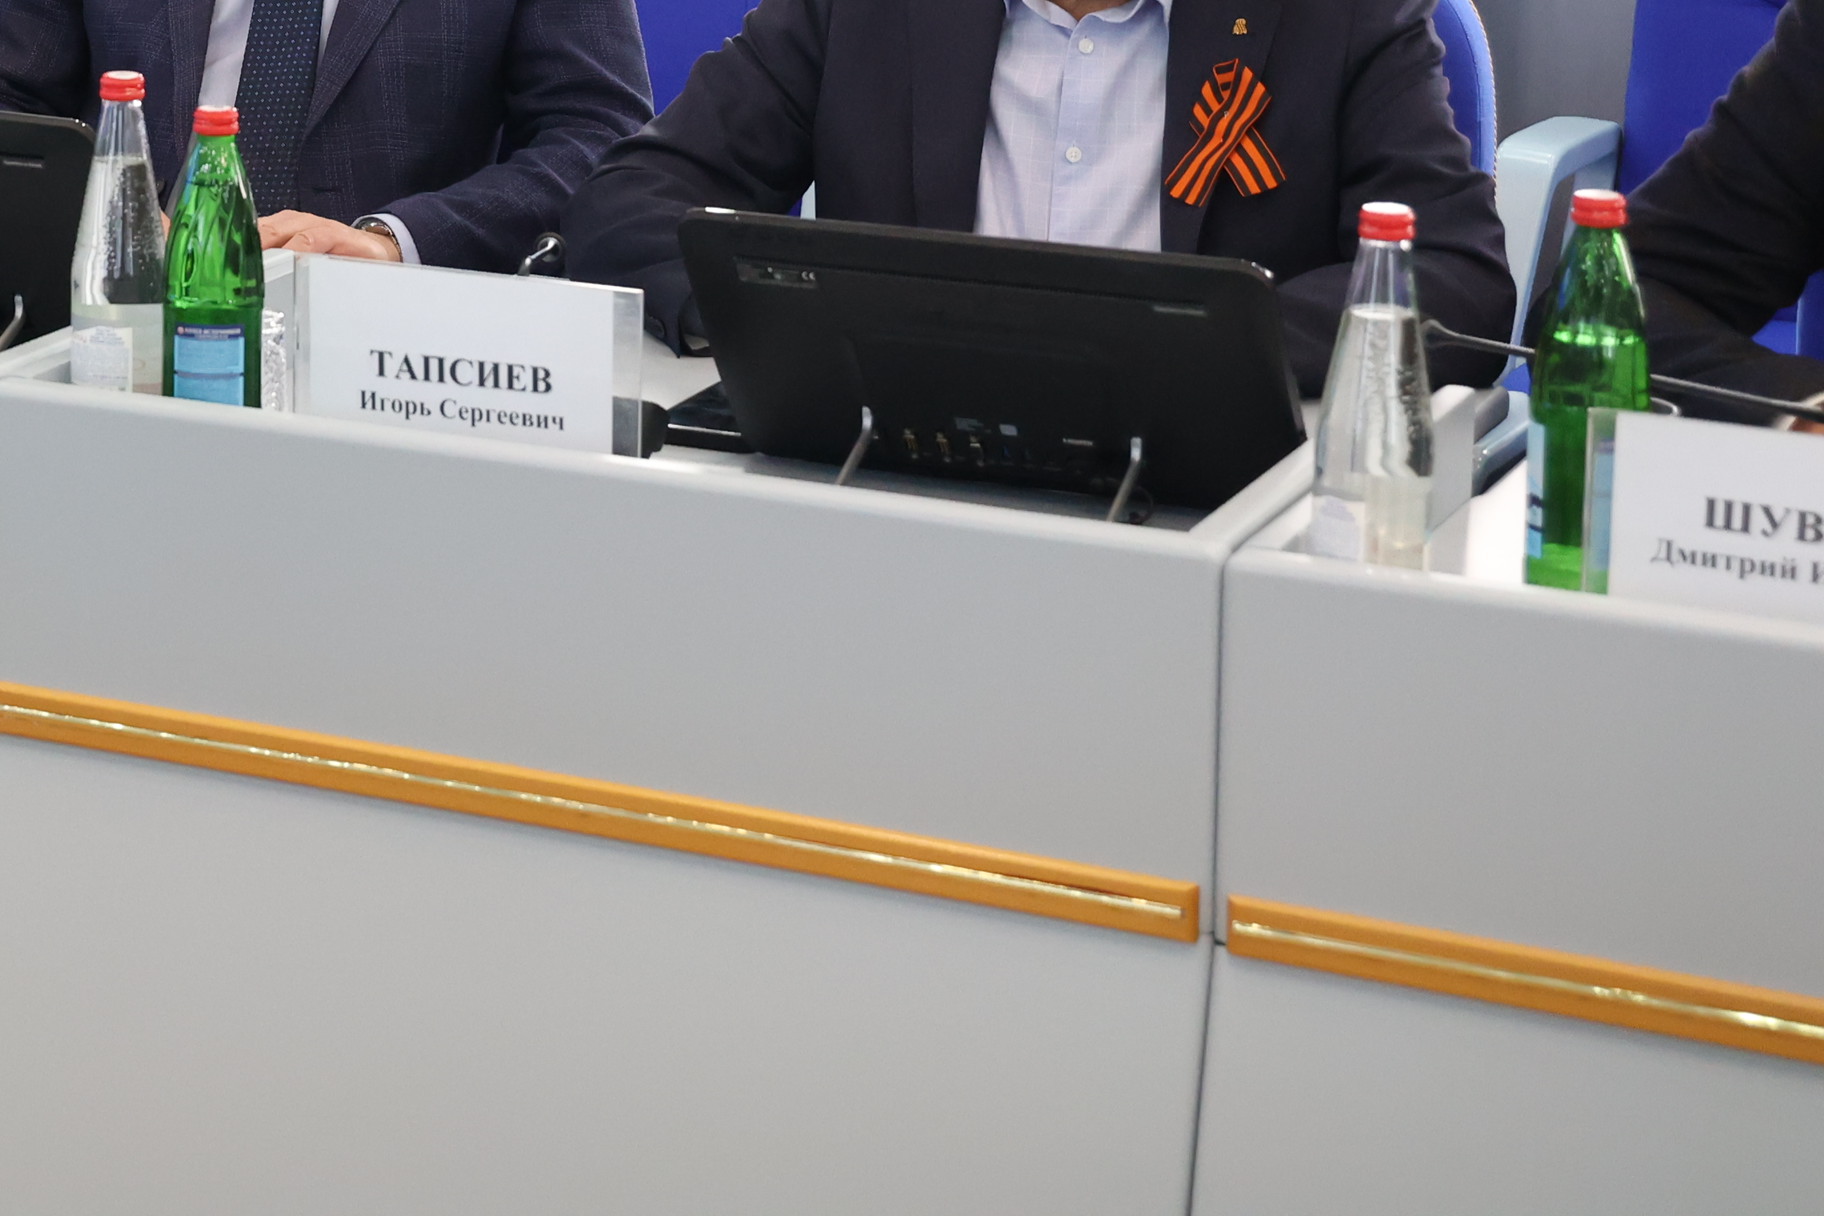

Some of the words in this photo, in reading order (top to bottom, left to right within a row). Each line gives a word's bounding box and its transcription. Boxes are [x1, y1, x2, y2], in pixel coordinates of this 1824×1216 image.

[369, 349, 553, 394] ТАПСИЕВ
[360, 389, 432, 420] Игорь
[439, 398, 565, 431] Сергеевич
[1704, 496, 1824, 543] ШУВ
[1650, 537, 1798, 581] Дмитрий
